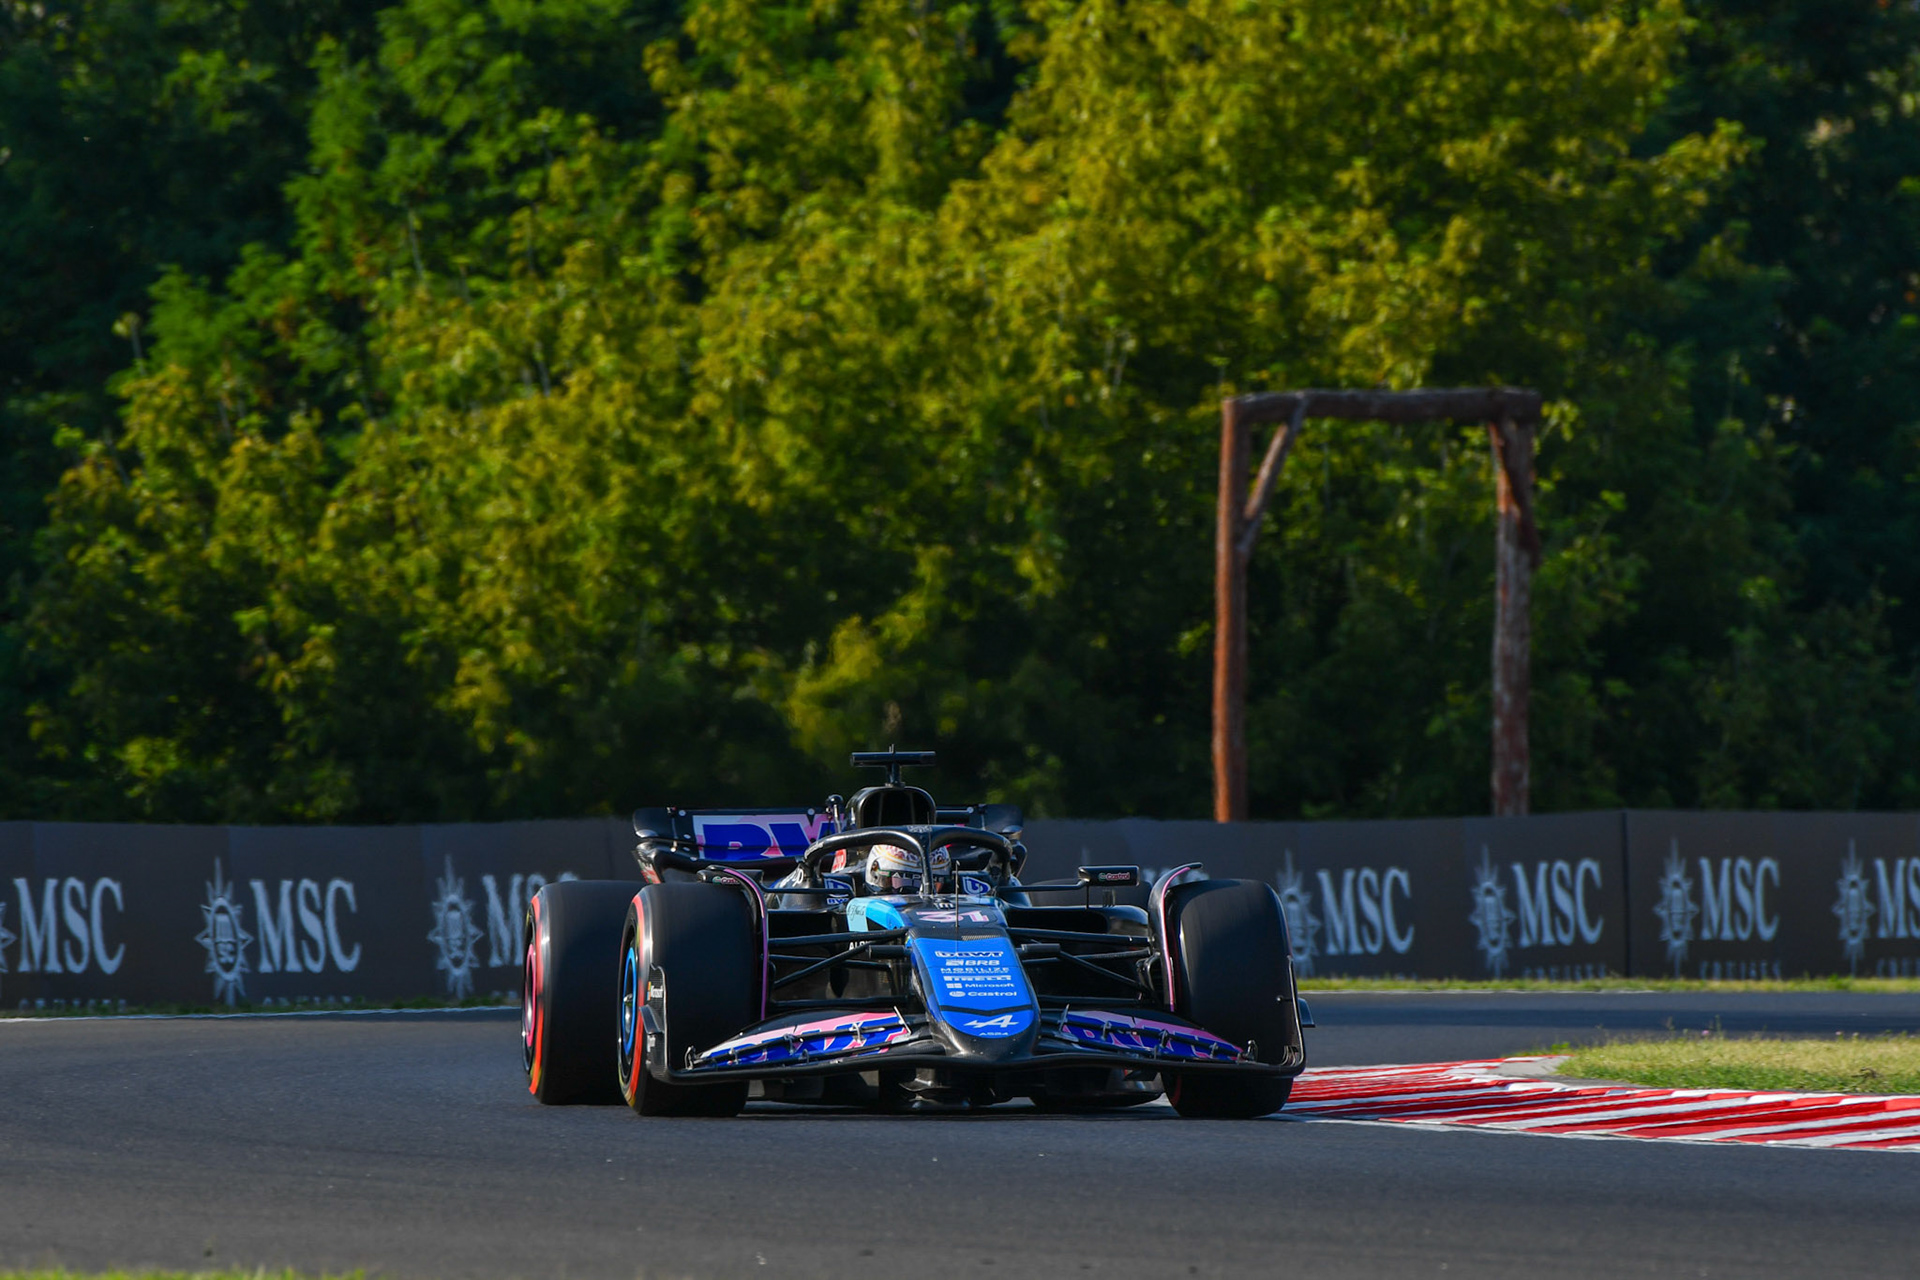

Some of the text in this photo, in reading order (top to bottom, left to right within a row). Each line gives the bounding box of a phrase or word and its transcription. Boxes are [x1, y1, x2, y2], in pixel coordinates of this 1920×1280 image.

[13, 877, 126, 974] MSC
[250, 878, 362, 973] MSC
[916, 910, 989, 922] 31
[1316, 866, 1415, 955] MSC
[1511, 857, 1604, 947] MSC
[1699, 857, 1780, 941] MSC
[1874, 857, 1920, 939] MS
